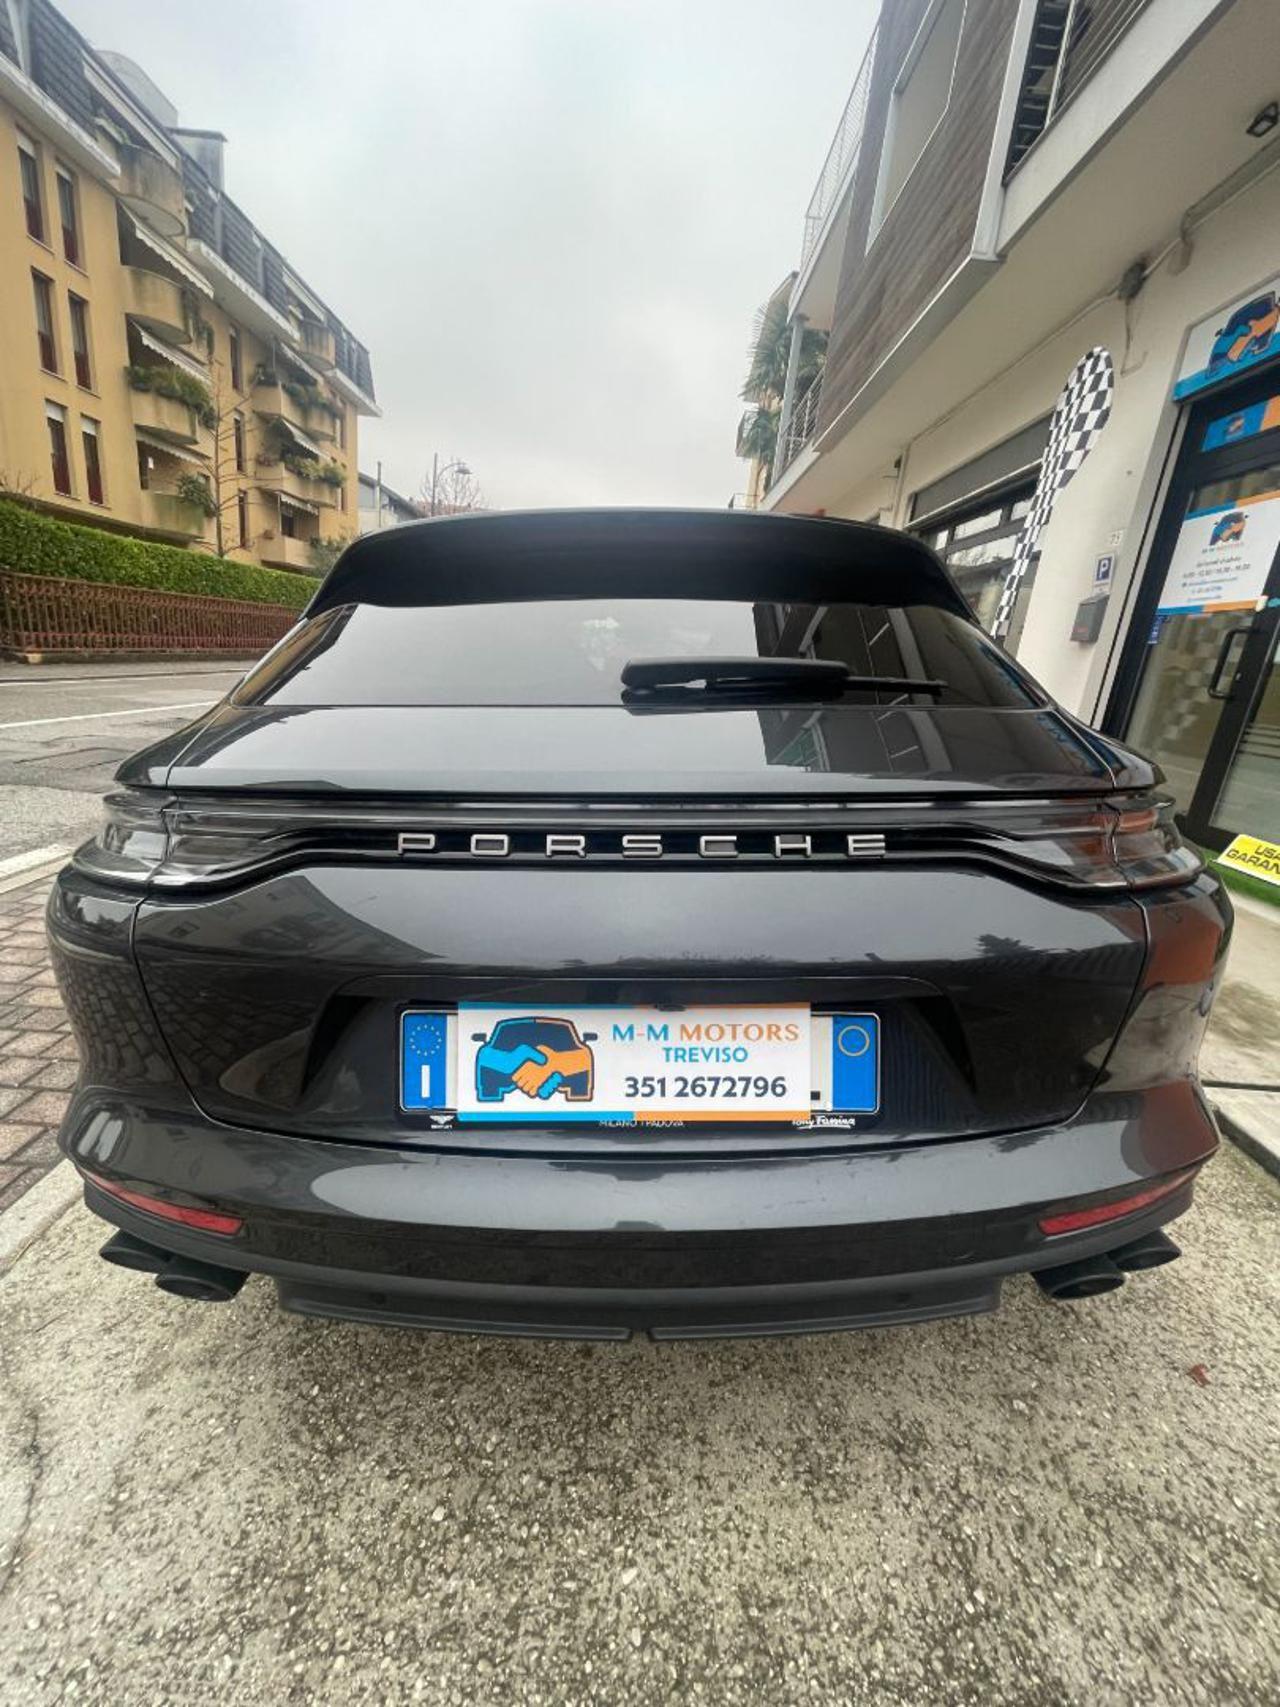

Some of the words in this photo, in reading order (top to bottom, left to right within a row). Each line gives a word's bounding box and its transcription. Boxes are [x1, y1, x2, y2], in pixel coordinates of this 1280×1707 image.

[1098, 559, 1109, 580] P
[397, 833, 886, 858] PORSCHE
[612, 1024, 669, 1041] M-M
[680, 1023, 800, 1042] MOTORS
[662, 1047, 749, 1063] TREVISO
[624, 1076, 667, 1098] 351
[674, 1076, 787, 1098] 2672796
